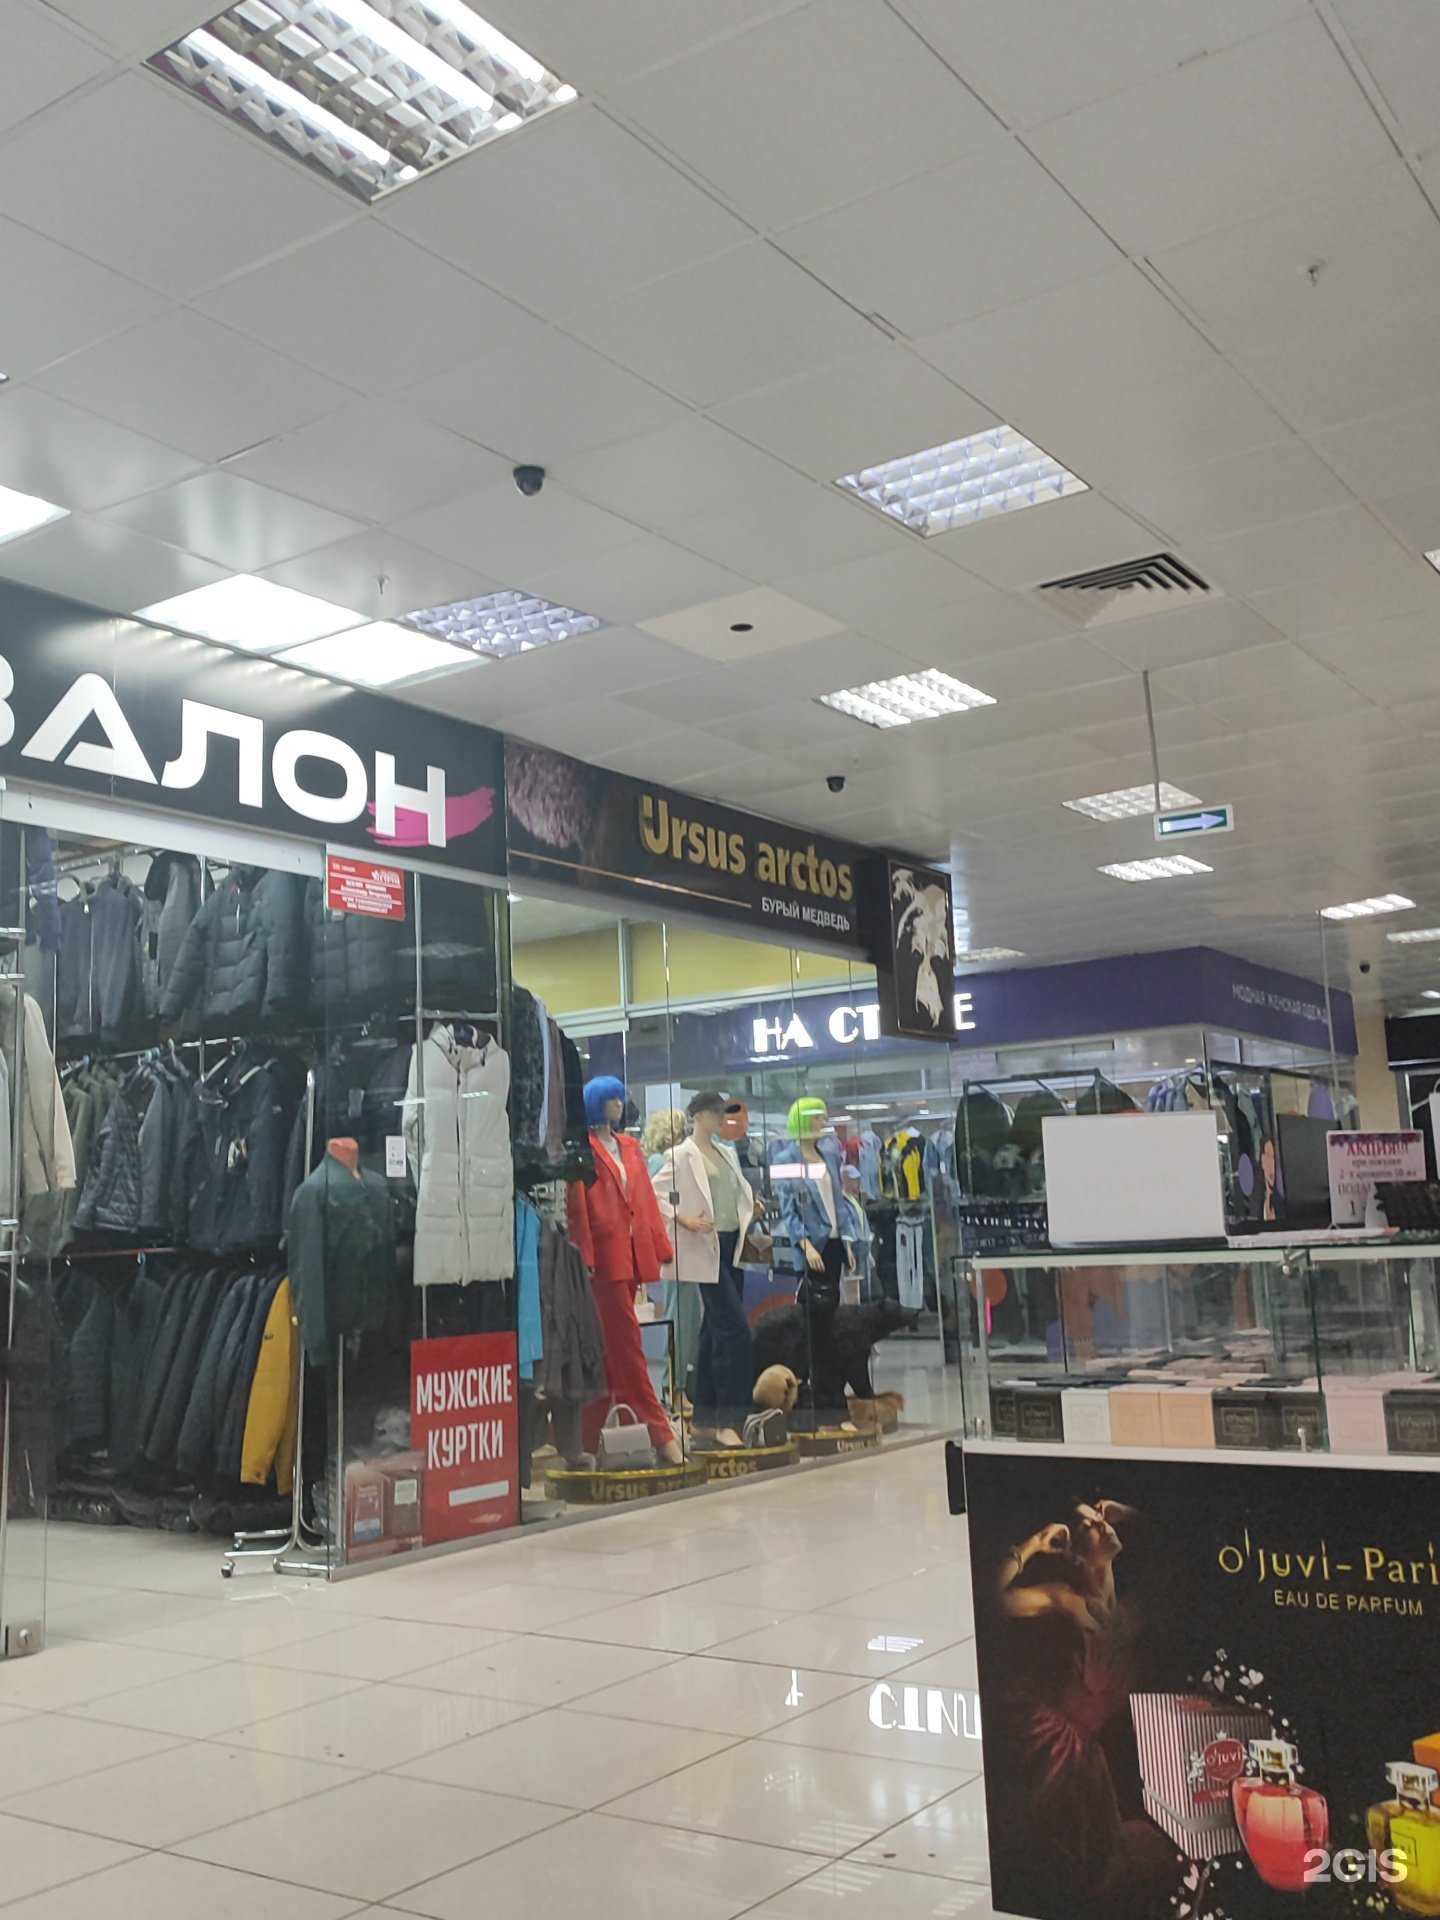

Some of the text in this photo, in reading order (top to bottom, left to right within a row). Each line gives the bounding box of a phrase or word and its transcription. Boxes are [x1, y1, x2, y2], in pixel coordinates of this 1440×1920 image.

[0, 653, 447, 848] АЛОН
[640, 794, 854, 902] Ursus arctos
[761, 896, 850, 932] БУРЫЙ МЕДВЕДЬ
[752, 1013, 814, 1053] НА
[416, 1363, 513, 1415] МУЖСКИЕ
[427, 1419, 504, 1470] КУРТКИ
[705, 1458, 758, 1478] rctos
[1274, 1589, 1423, 1617] EAU DE PARFUM
